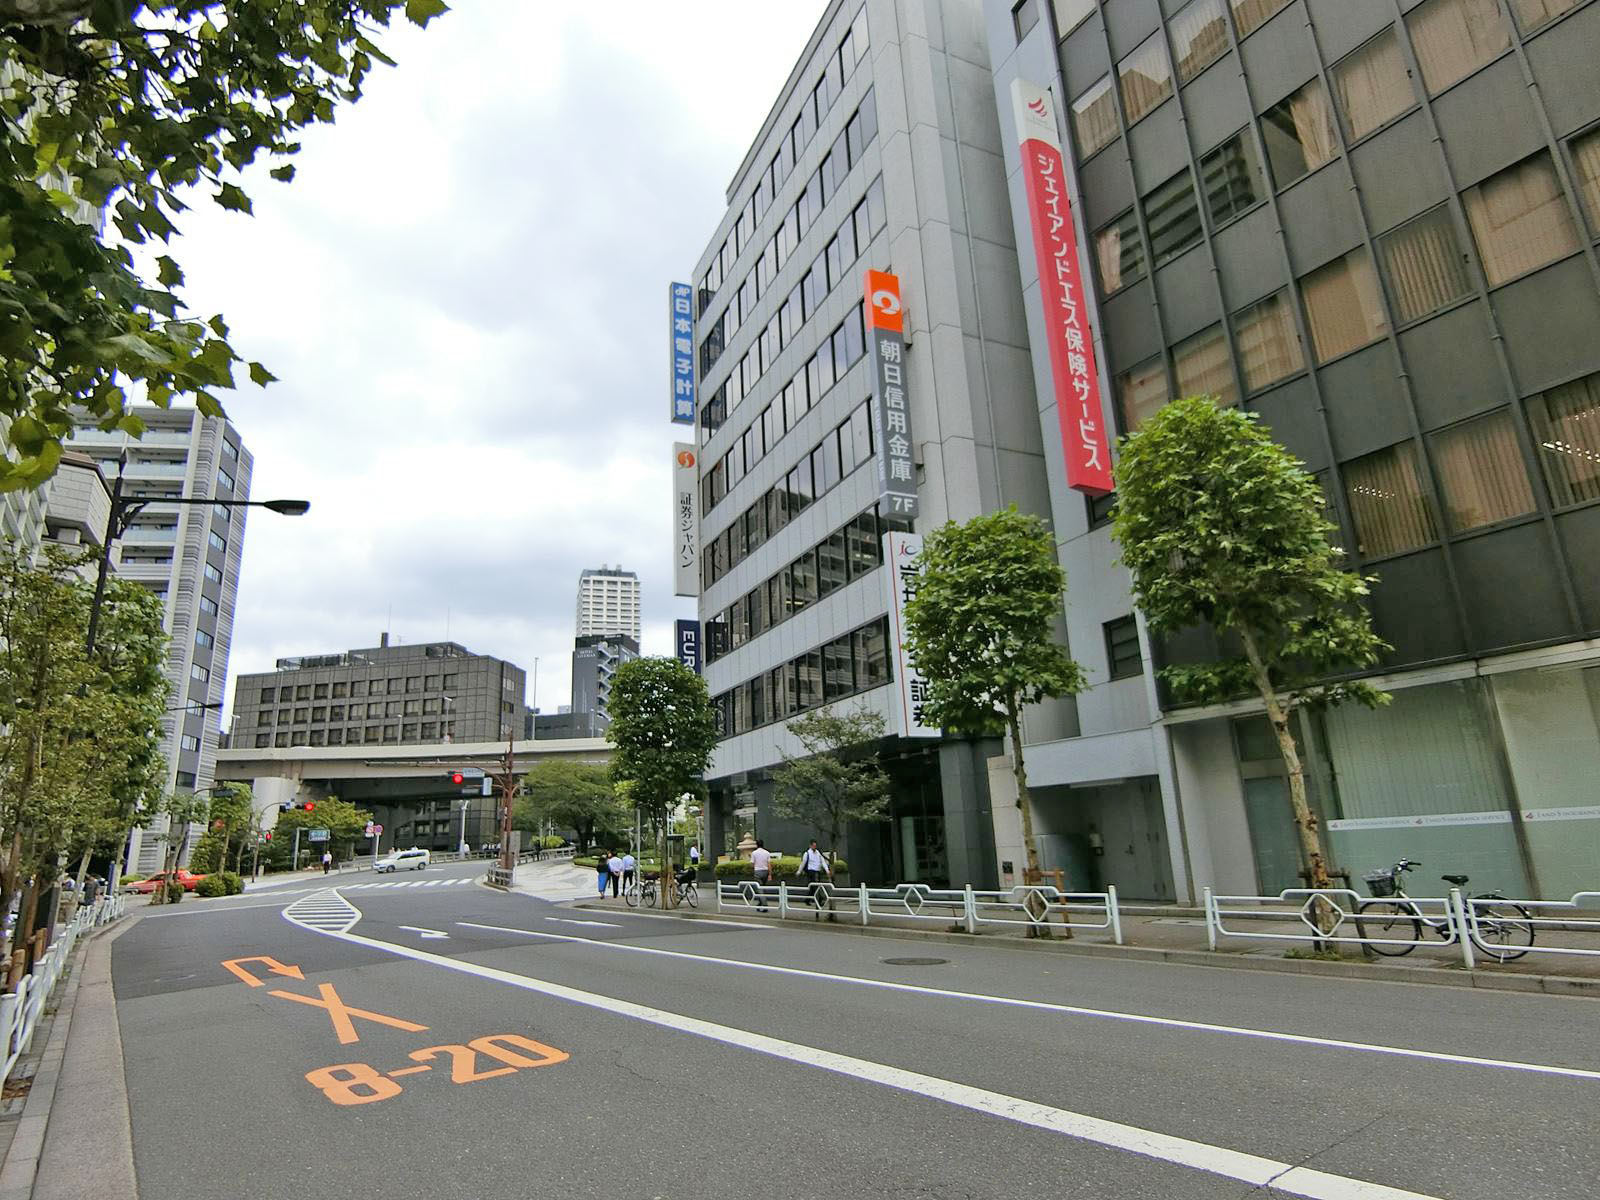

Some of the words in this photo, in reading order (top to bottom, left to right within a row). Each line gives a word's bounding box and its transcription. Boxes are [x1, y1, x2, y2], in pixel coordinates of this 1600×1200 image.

[1037, 152, 1101, 472] ジェイアンドエス保険サービス
[675, 298, 693, 417] 日本電子計算
[880, 340, 912, 482] 朝日信用金庫
[680, 491, 694, 569] 証券ジャパン
[893, 497, 914, 513] 7F
[682, 630, 696, 674] EUR
[304, 1033, 570, 1106] 8-20
